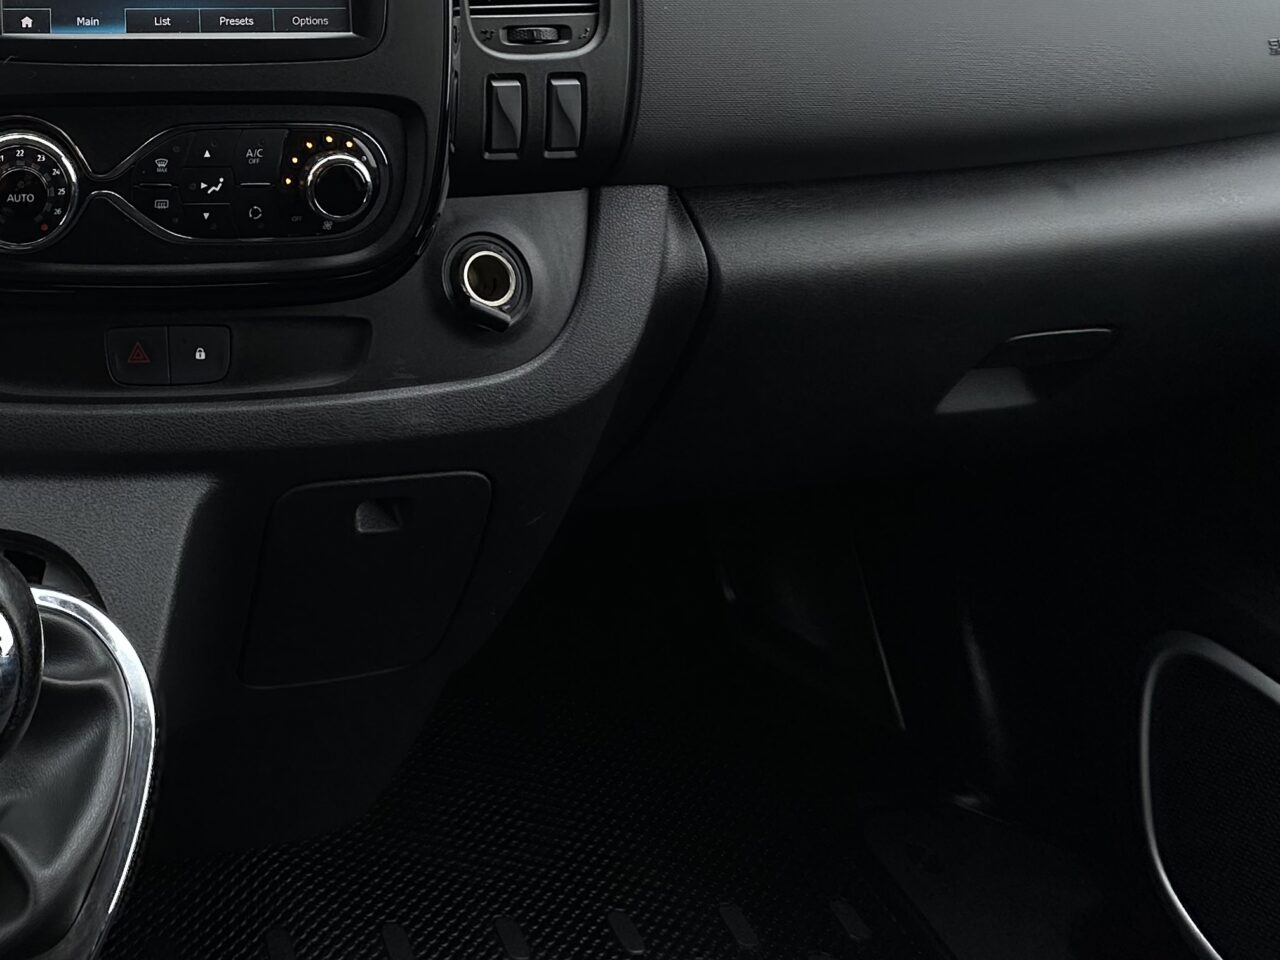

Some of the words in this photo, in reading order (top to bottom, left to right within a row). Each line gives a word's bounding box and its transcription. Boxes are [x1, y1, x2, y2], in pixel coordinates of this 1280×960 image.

[76, 16, 100, 27] Main
[154, 16, 171, 27] List
[219, 16, 254, 27] Presets
[292, 16, 329, 28] Options
[15, 149, 25, 157] 22
[245, 148, 264, 159] A/C
[52, 168, 61, 176] 24
[57, 187, 66, 196] 25
[6, 193, 35, 203] AUTO
